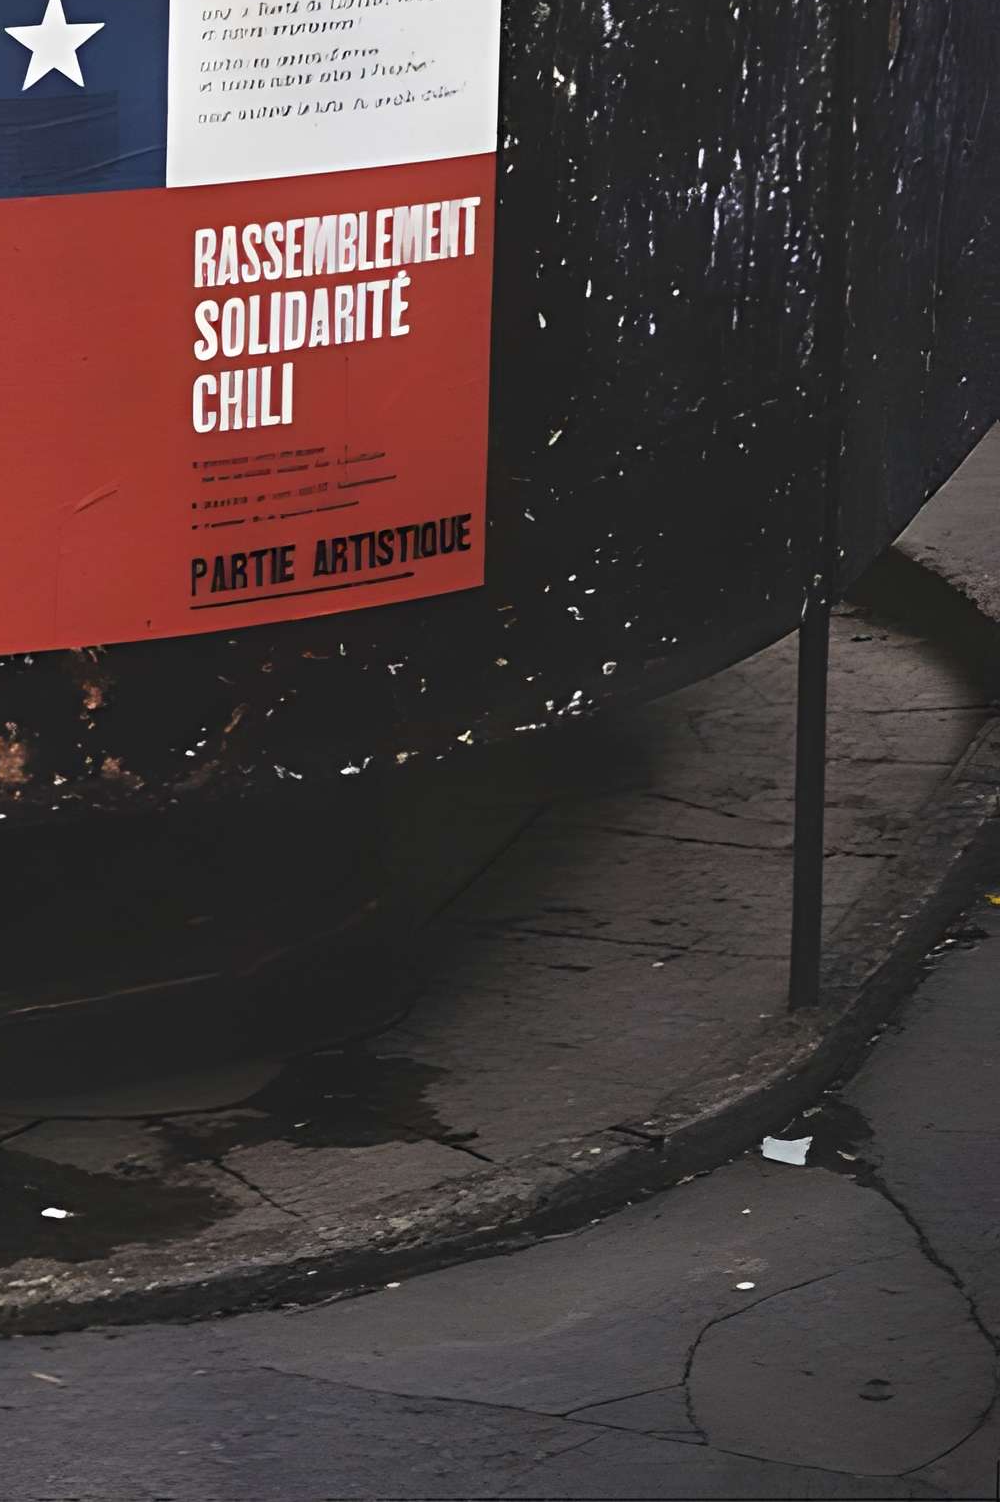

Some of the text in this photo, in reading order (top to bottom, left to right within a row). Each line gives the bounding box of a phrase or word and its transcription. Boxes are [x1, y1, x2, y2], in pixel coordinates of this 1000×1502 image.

[193, 197, 481, 288] RASSEMBLEMENT
[193, 270, 411, 361] SOLIDARITÉ
[192, 362, 294, 433] CHILI
[191, 544, 297, 597] PARTIE
[313, 513, 473, 577] ARTISTIQUE
